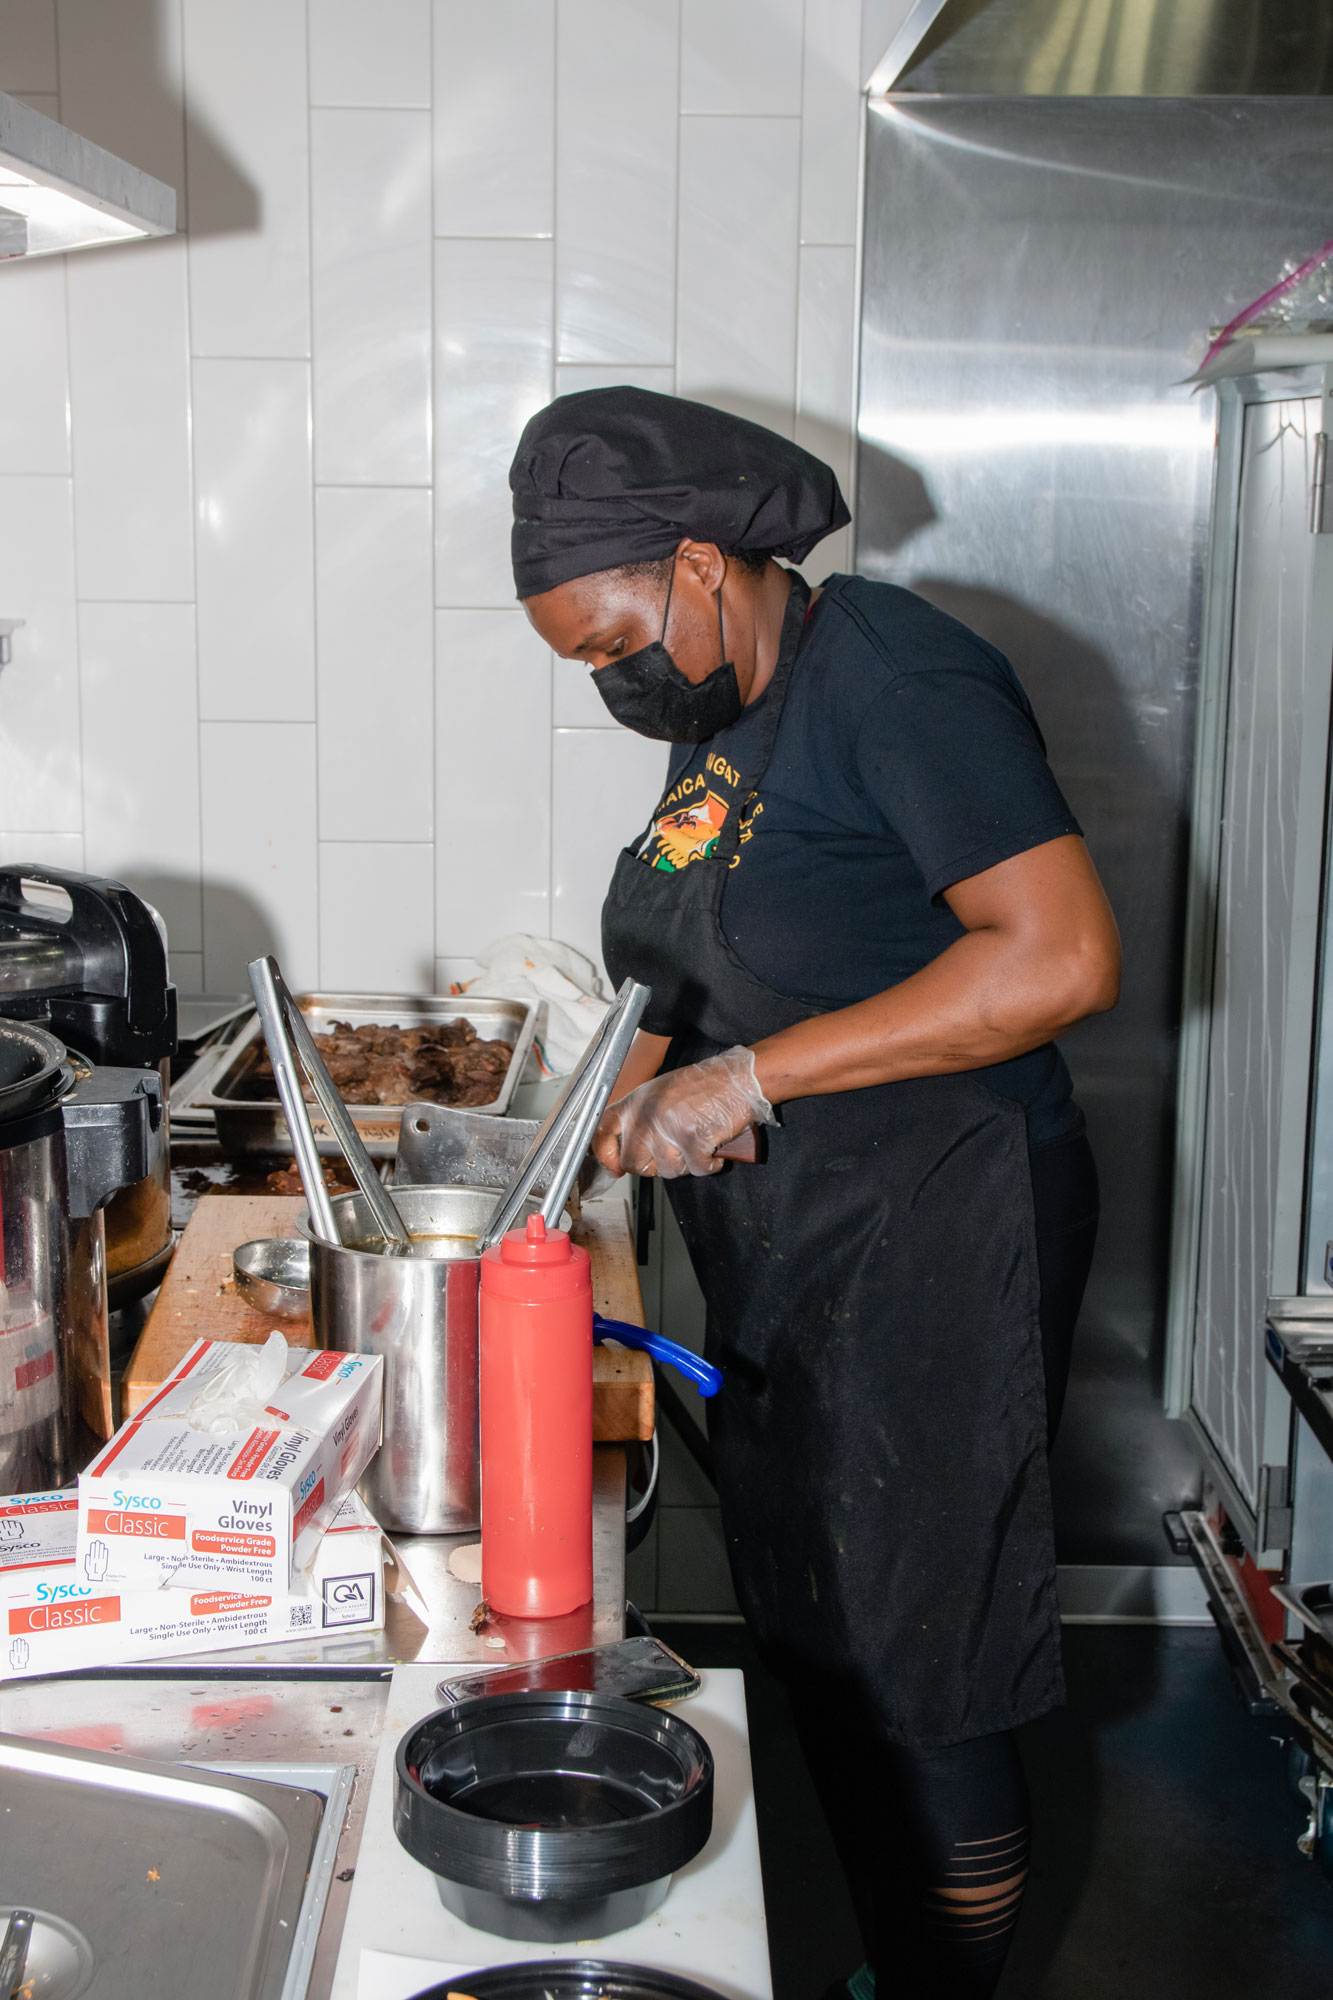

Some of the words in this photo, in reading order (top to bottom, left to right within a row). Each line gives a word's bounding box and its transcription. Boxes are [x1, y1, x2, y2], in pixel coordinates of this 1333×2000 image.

[337, 1361, 363, 1379] Sysco
[344, 1406, 359, 1431] Gloves
[266, 1450, 297, 1481] Gloves
[300, 1470, 316, 1500] Sysco
[10, 1494, 63, 1505] Sysco
[113, 1490, 162, 1510] Sysco
[5, 1502, 75, 1516] Classic
[232, 1500, 273, 1519] Vinyl
[104, 1513, 169, 1537] Classic
[218, 1515, 273, 1532] Gloves
[0, 1542, 41, 1552] Sysco
[195, 1533, 244, 1545] Foodservice
[246, 1538, 272, 1547] Grade
[220, 1544, 252, 1554] Powder
[253, 1546, 272, 1555] Free
[143, 1553, 165, 1562] Large
[220, 1557, 273, 1568] Ambidextrous
[188, 1562, 202, 1570] Use
[203, 1563, 220, 1573] Only
[226, 1565, 245, 1574] Wrist
[246, 1567, 273, 1576] Length
[250, 1575, 265, 1583] 100
[193, 1593, 242, 1605] Foodservice
[218, 1600, 249, 1611] Powder
[250, 1598, 268, 1606] Free
[28, 1603, 102, 1630] Classic
[130, 1627, 153, 1635] Large
[159, 1619, 205, 1631] Non-Sterile
[211, 1612, 268, 1624] Ambidextrous
[149, 1631, 175, 1641] Single
[192, 1626, 211, 1636] Only
[217, 1623, 238, 1632] Wrist
[239, 1619, 268, 1630] Length
[244, 1628, 258, 1636] 100
